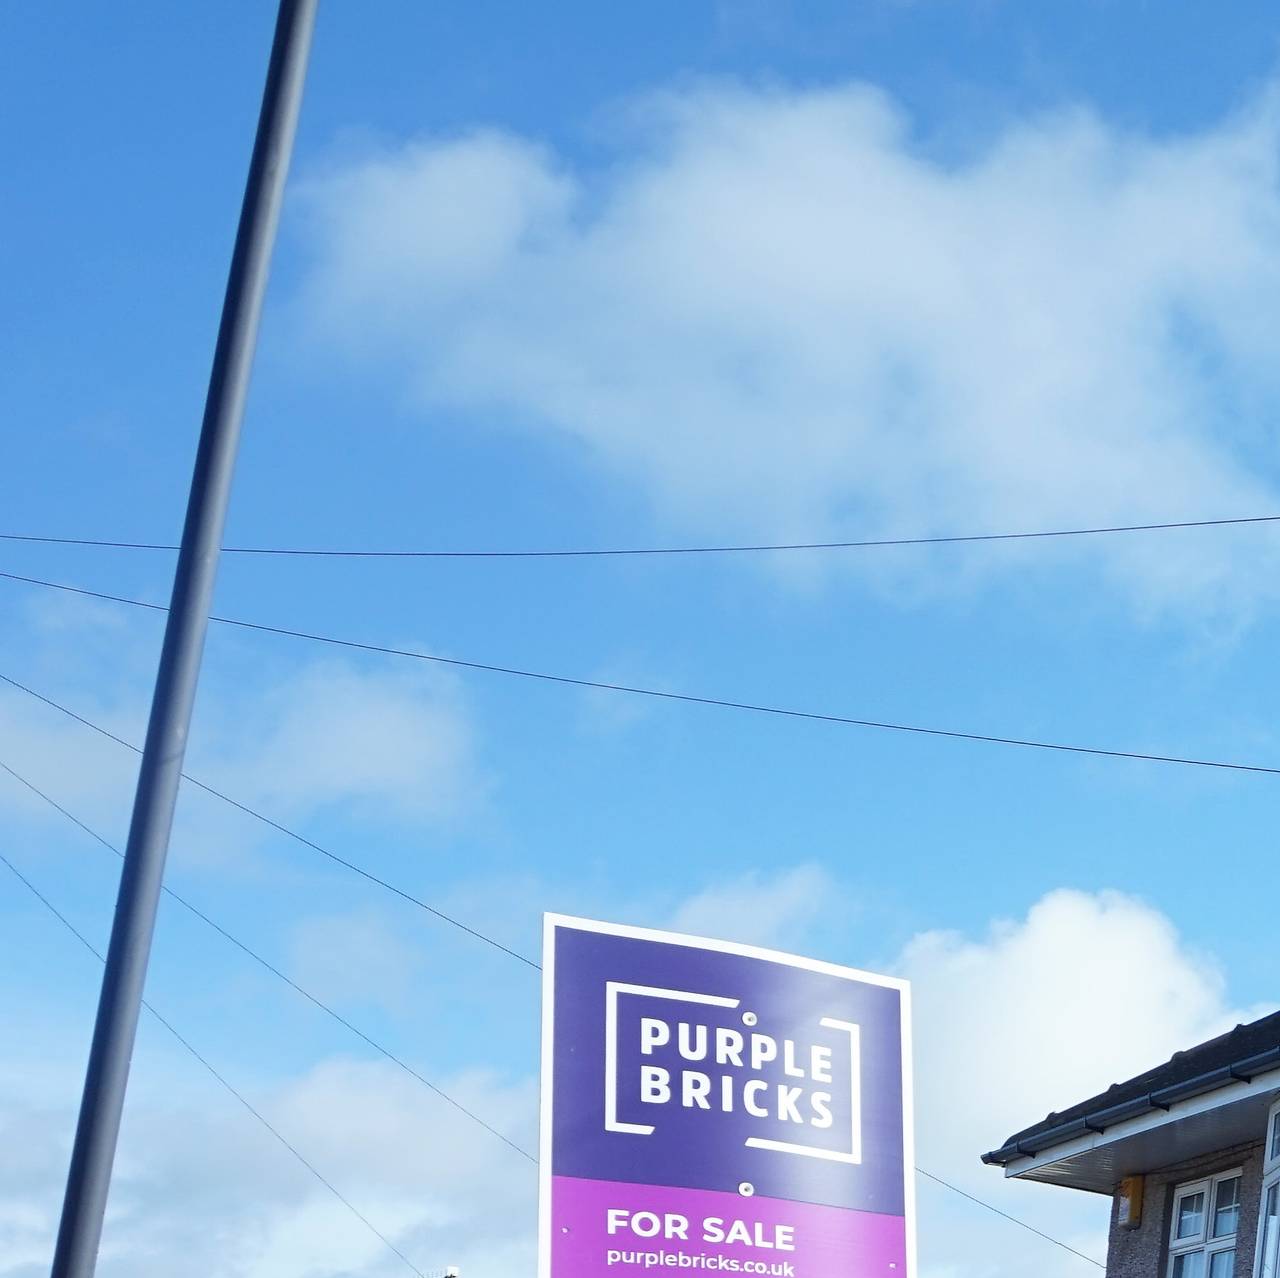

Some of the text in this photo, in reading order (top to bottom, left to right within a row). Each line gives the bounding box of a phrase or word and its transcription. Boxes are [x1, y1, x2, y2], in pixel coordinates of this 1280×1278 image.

[640, 1017, 833, 1083] PURPLE
[640, 1065, 833, 1129] BRICKS
[607, 1208, 795, 1251] FOR SALE
[606, 1249, 795, 1277] purplebricks.co.uk
